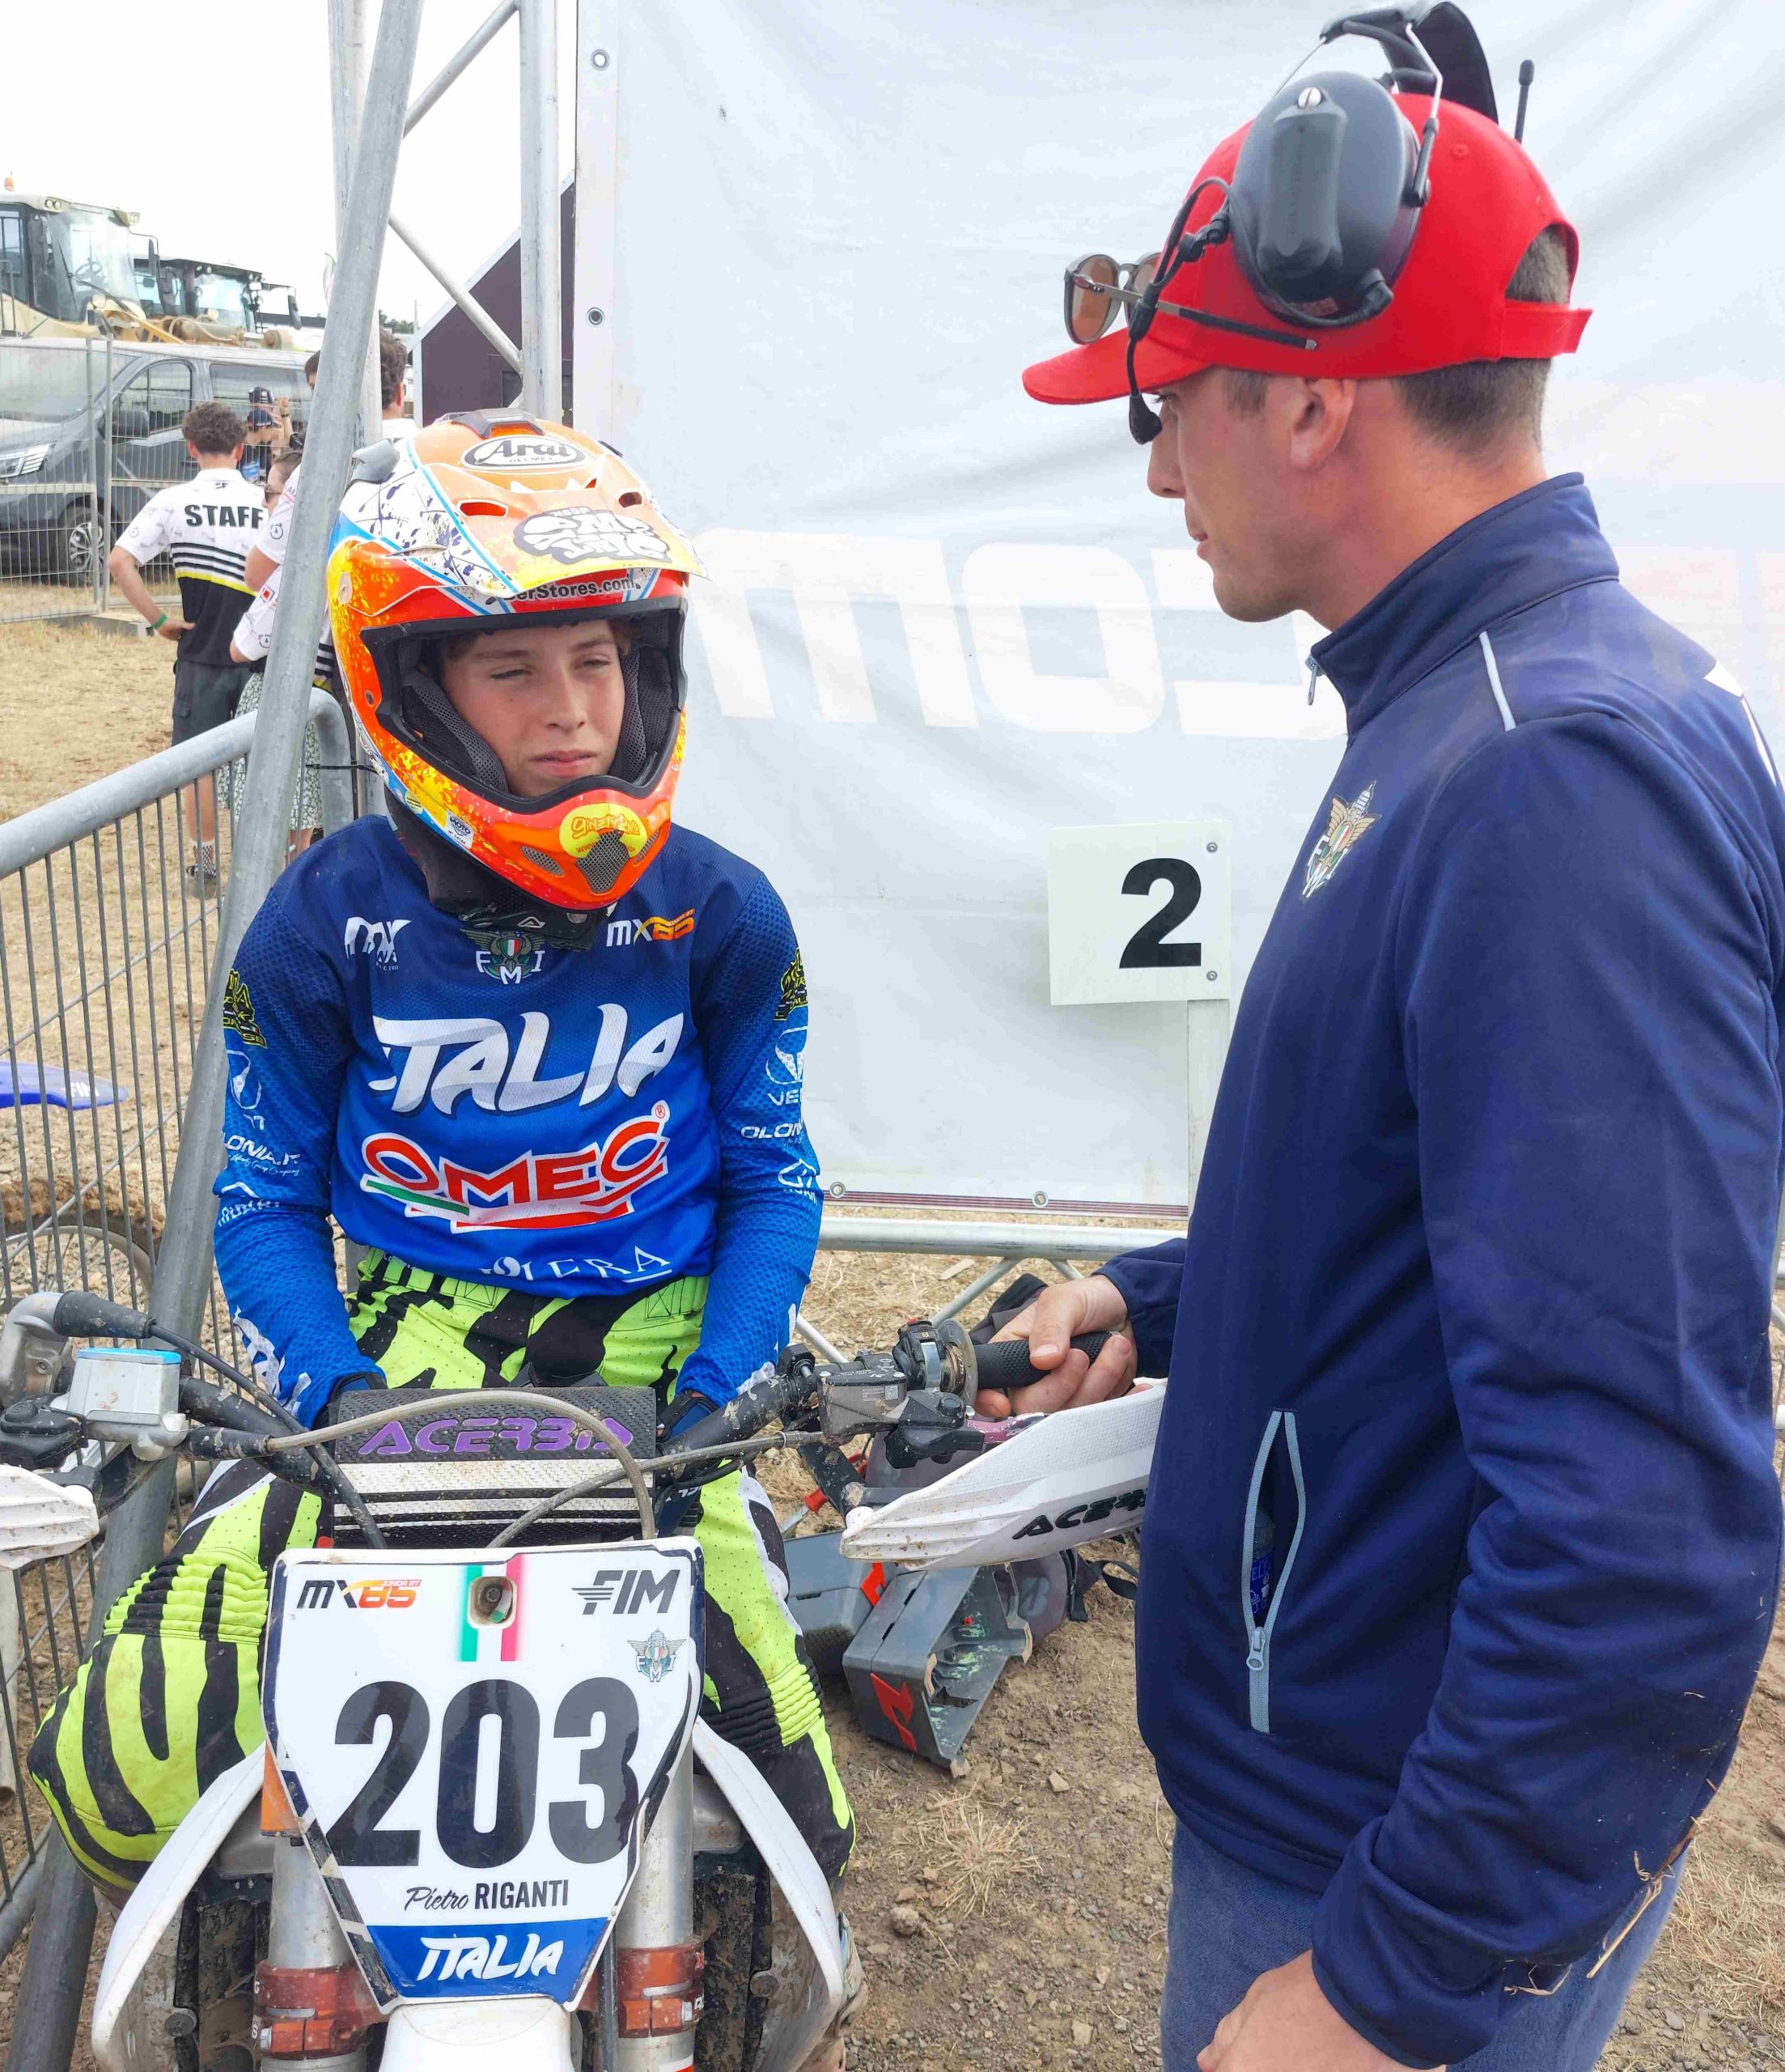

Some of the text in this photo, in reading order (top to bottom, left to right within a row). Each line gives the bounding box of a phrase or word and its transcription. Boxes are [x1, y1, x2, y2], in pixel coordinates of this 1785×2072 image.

[476, 439, 572, 465] Arai
[184, 504, 264, 529] STAFF
[507, 579, 635, 601] erStores.com
[1119, 858, 1202, 970] 2
[365, 1119, 667, 1206] OMEC
[570, 1569, 681, 1615] FIM
[324, 1677, 642, 1869] 203
[404, 1879, 569, 1912] Pietro RIGANTI
[417, 1933, 565, 1981] ITALIA
